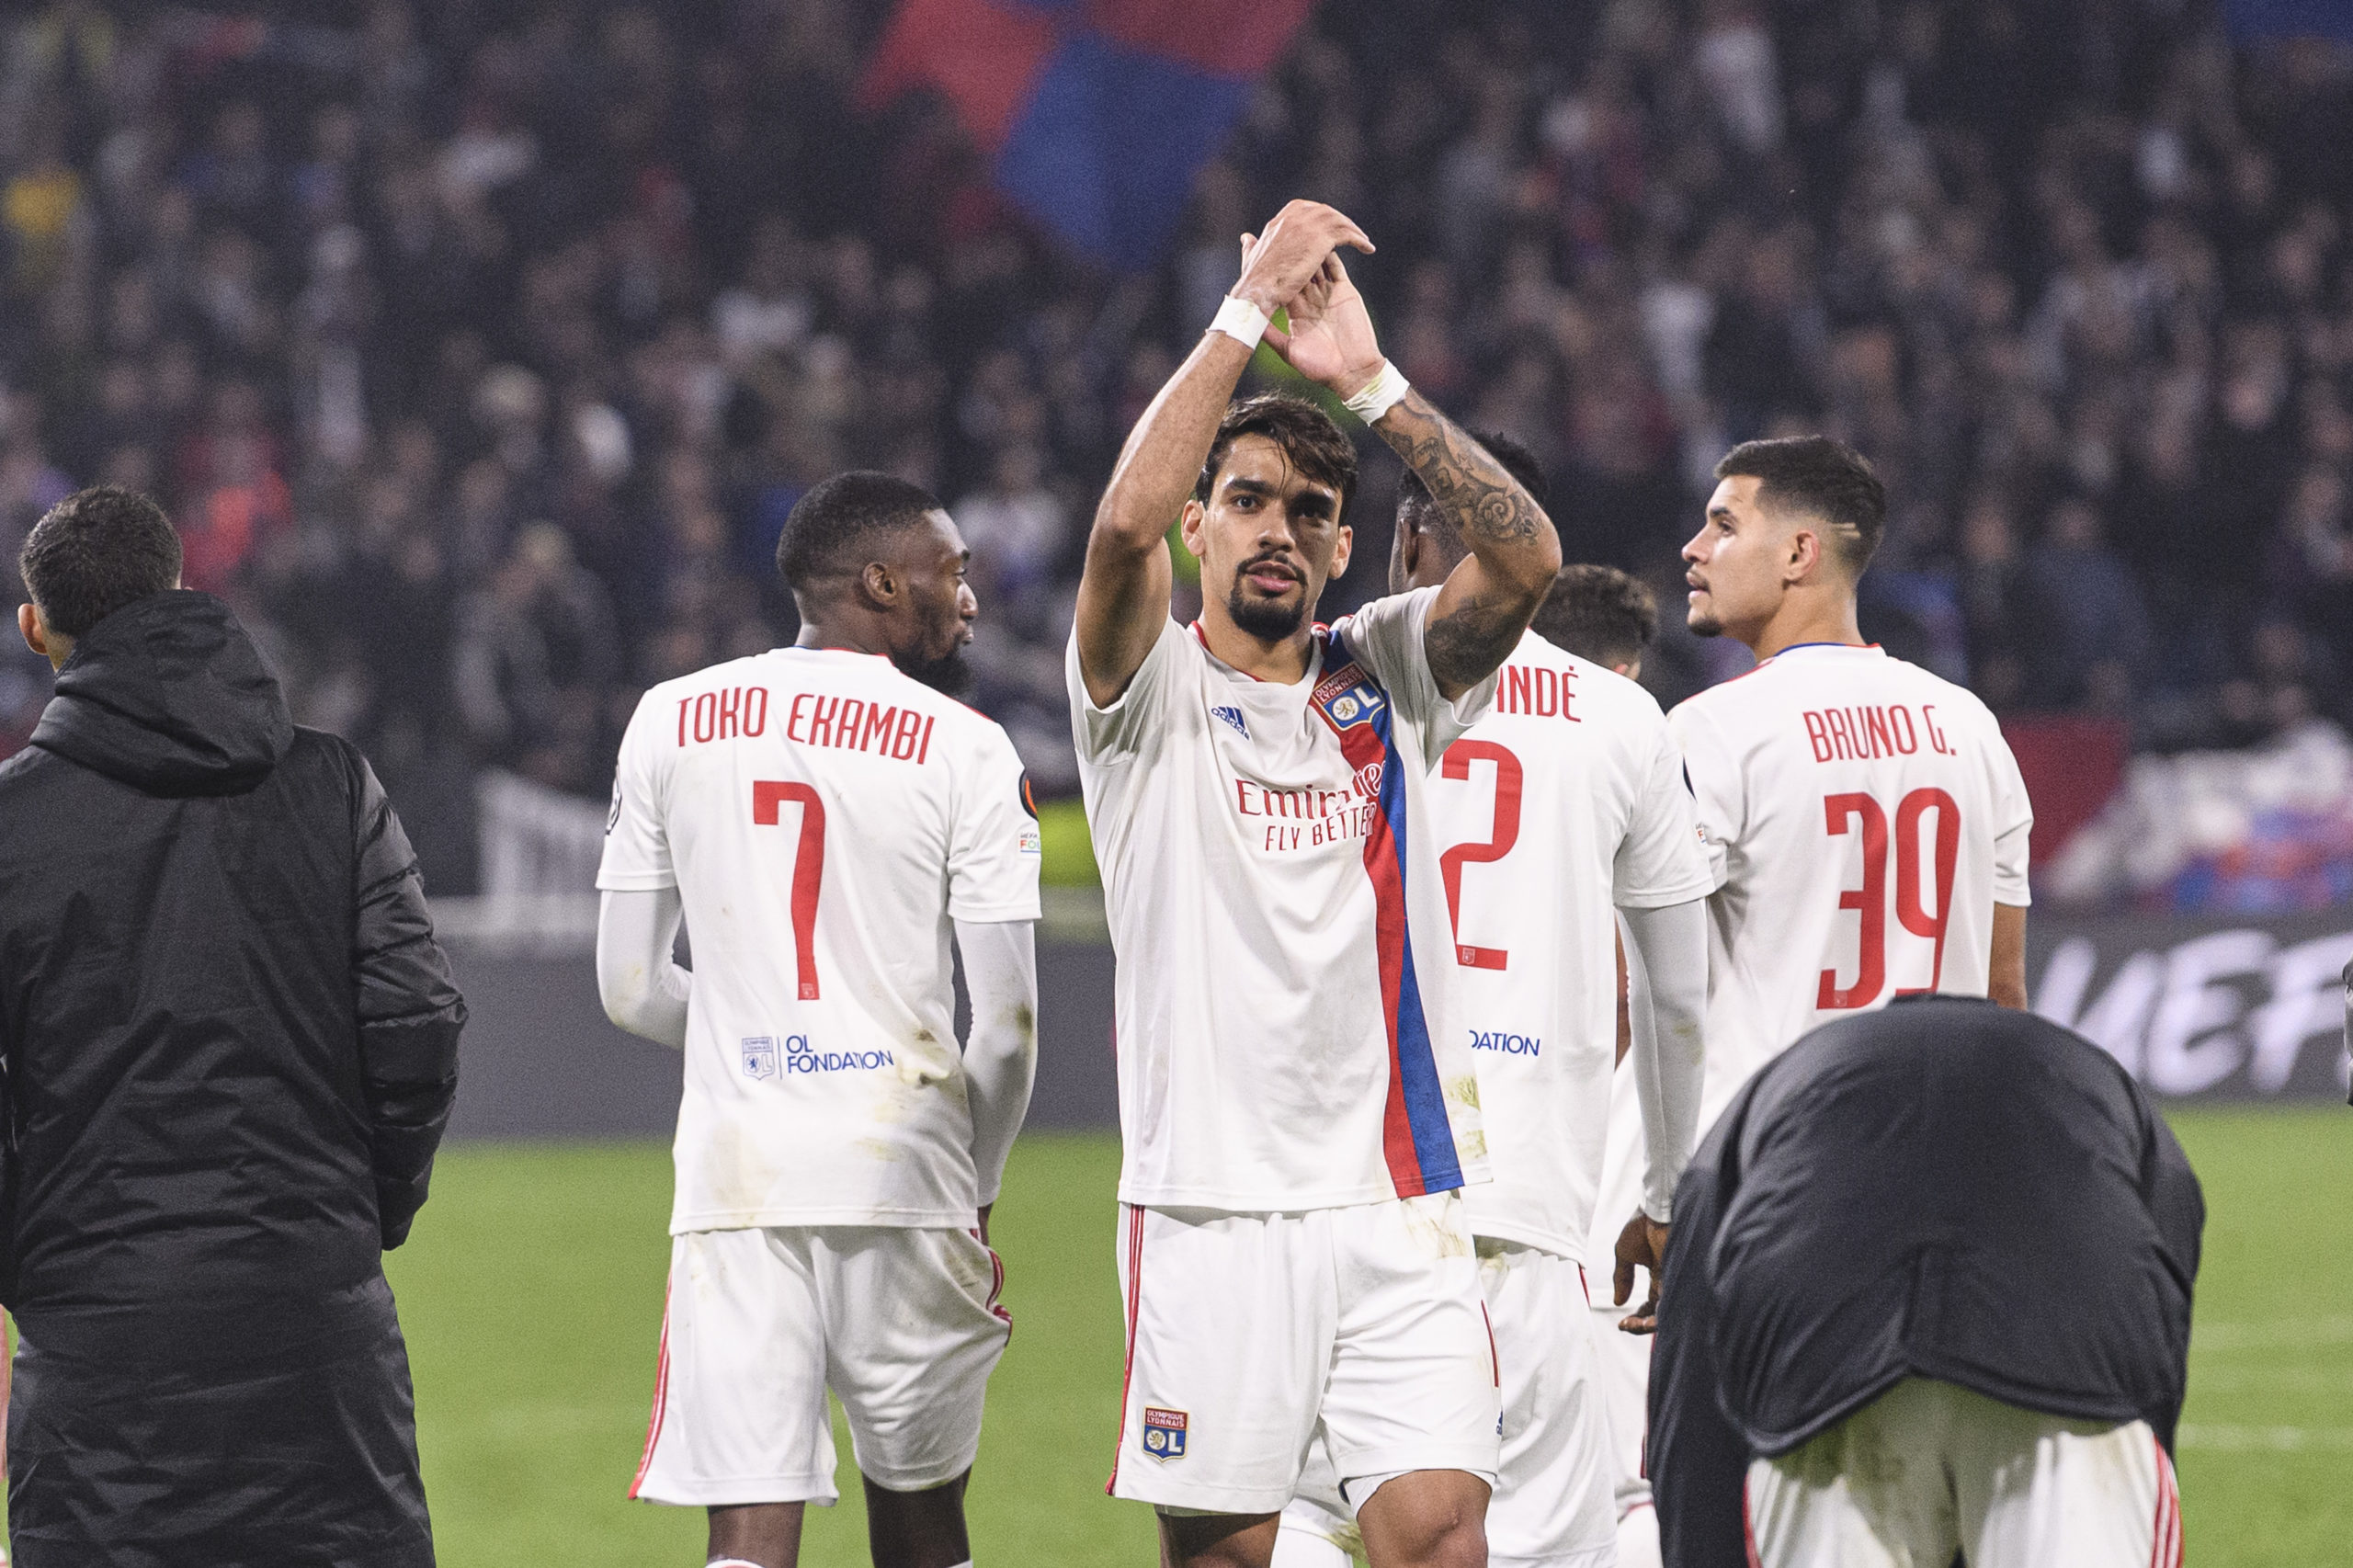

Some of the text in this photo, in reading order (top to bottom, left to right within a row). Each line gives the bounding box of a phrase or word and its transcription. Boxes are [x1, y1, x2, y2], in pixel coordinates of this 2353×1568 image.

[1315, 666, 1357, 697] OLYMPIQUE
[1320, 673, 1363, 702] LYONNAIS
[676, 687, 936, 765] TOKO EKAMBI
[1211, 706, 1250, 741] adidas
[1802, 704, 1957, 763] BRUNO G.
[1265, 801, 1377, 851] FLY BETTER
[1439, 739, 1524, 971] 2
[753, 780, 825, 1001] 7
[1816, 787, 1961, 1010] 39
[2033, 928, 2353, 1094] UEF
[786, 1035, 813, 1054] OL
[788, 1051, 894, 1074] FONDATION
[1146, 1409, 1185, 1420] OLYMPIQUE
[1146, 1416, 1185, 1427] LYONNAIS
